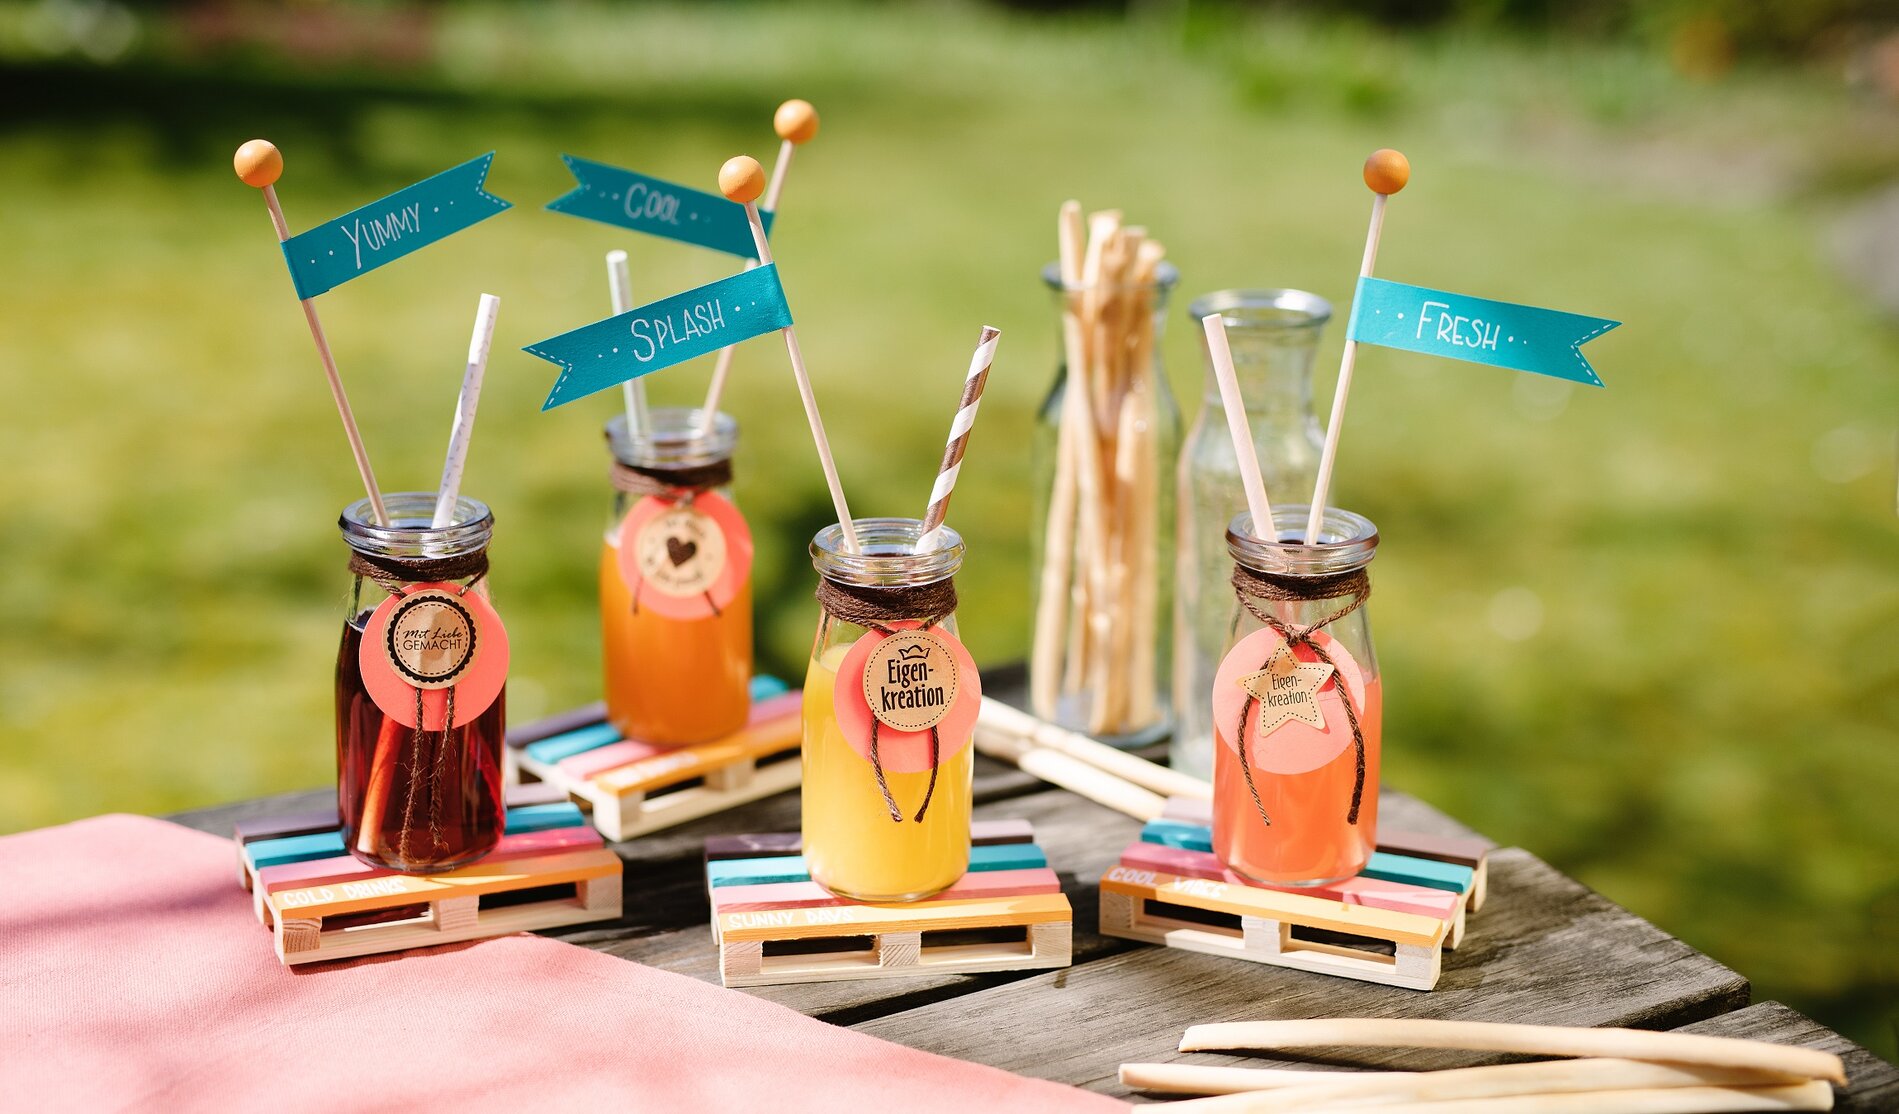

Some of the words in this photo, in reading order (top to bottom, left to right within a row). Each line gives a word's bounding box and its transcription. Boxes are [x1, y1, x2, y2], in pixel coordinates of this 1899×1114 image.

[340, 202, 420, 270] YUMMY
[630, 298, 726, 362] SPLASH
[1416, 301, 1500, 351] FRESH
[402, 629, 431, 639] Mit
[431, 627, 463, 640] Liebe
[402, 639, 462, 651] GEMACHT
[887, 659, 934, 688] Eigen-
[1271, 673, 1302, 690] Eigen-
[880, 684, 944, 712] kreation
[1266, 688, 1308, 708] kreation
[282, 887, 335, 907] COLD
[341, 877, 408, 899] DRINKS
[728, 911, 795, 929] SUNNY
